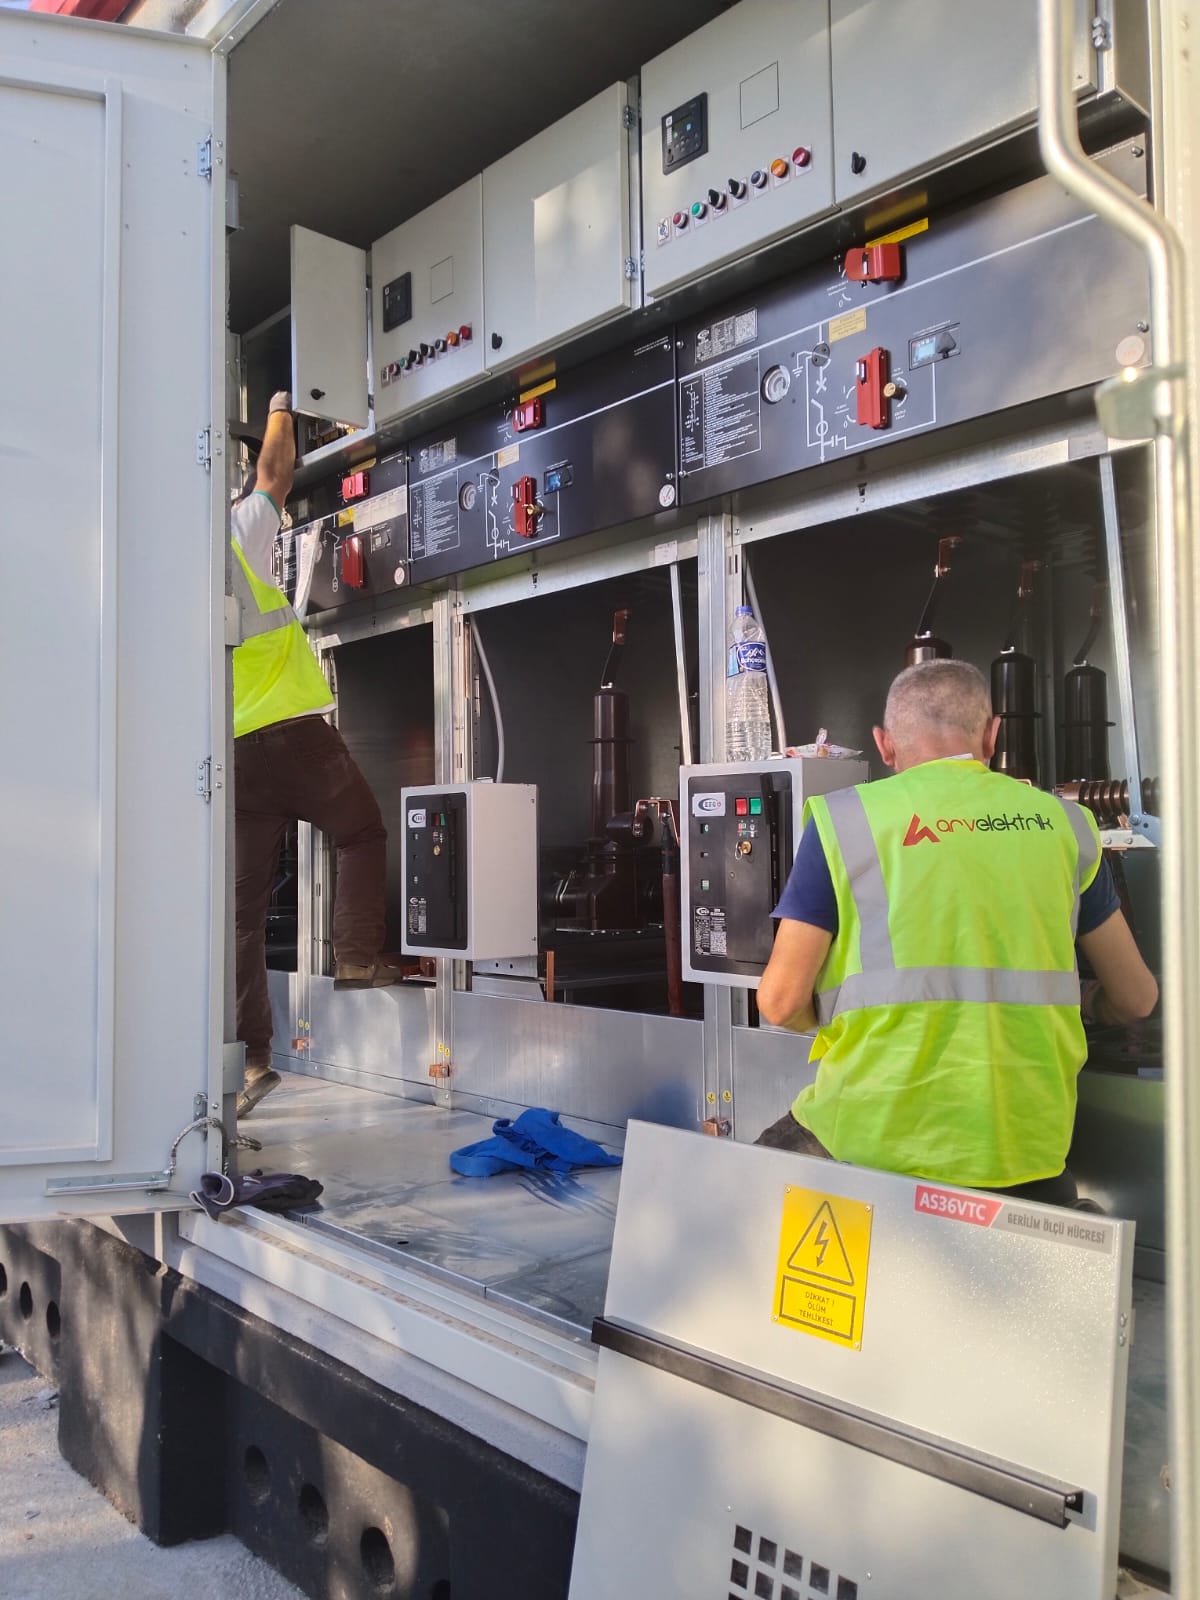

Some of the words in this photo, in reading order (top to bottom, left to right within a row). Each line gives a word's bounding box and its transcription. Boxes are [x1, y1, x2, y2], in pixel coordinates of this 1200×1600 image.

[919, 1191, 987, 1220] AS36VTC
[1007, 1212, 1041, 1230] GERİLİM
[1043, 1217, 1065, 1236] ÖLÇÜ
[1067, 1223, 1106, 1245] HÜCRESİ
[805, 1291, 830, 1304] DİKKAT
[807, 1301, 827, 1314] ÖLÜM
[799, 1309, 834, 1326] TEHLİKESİ
